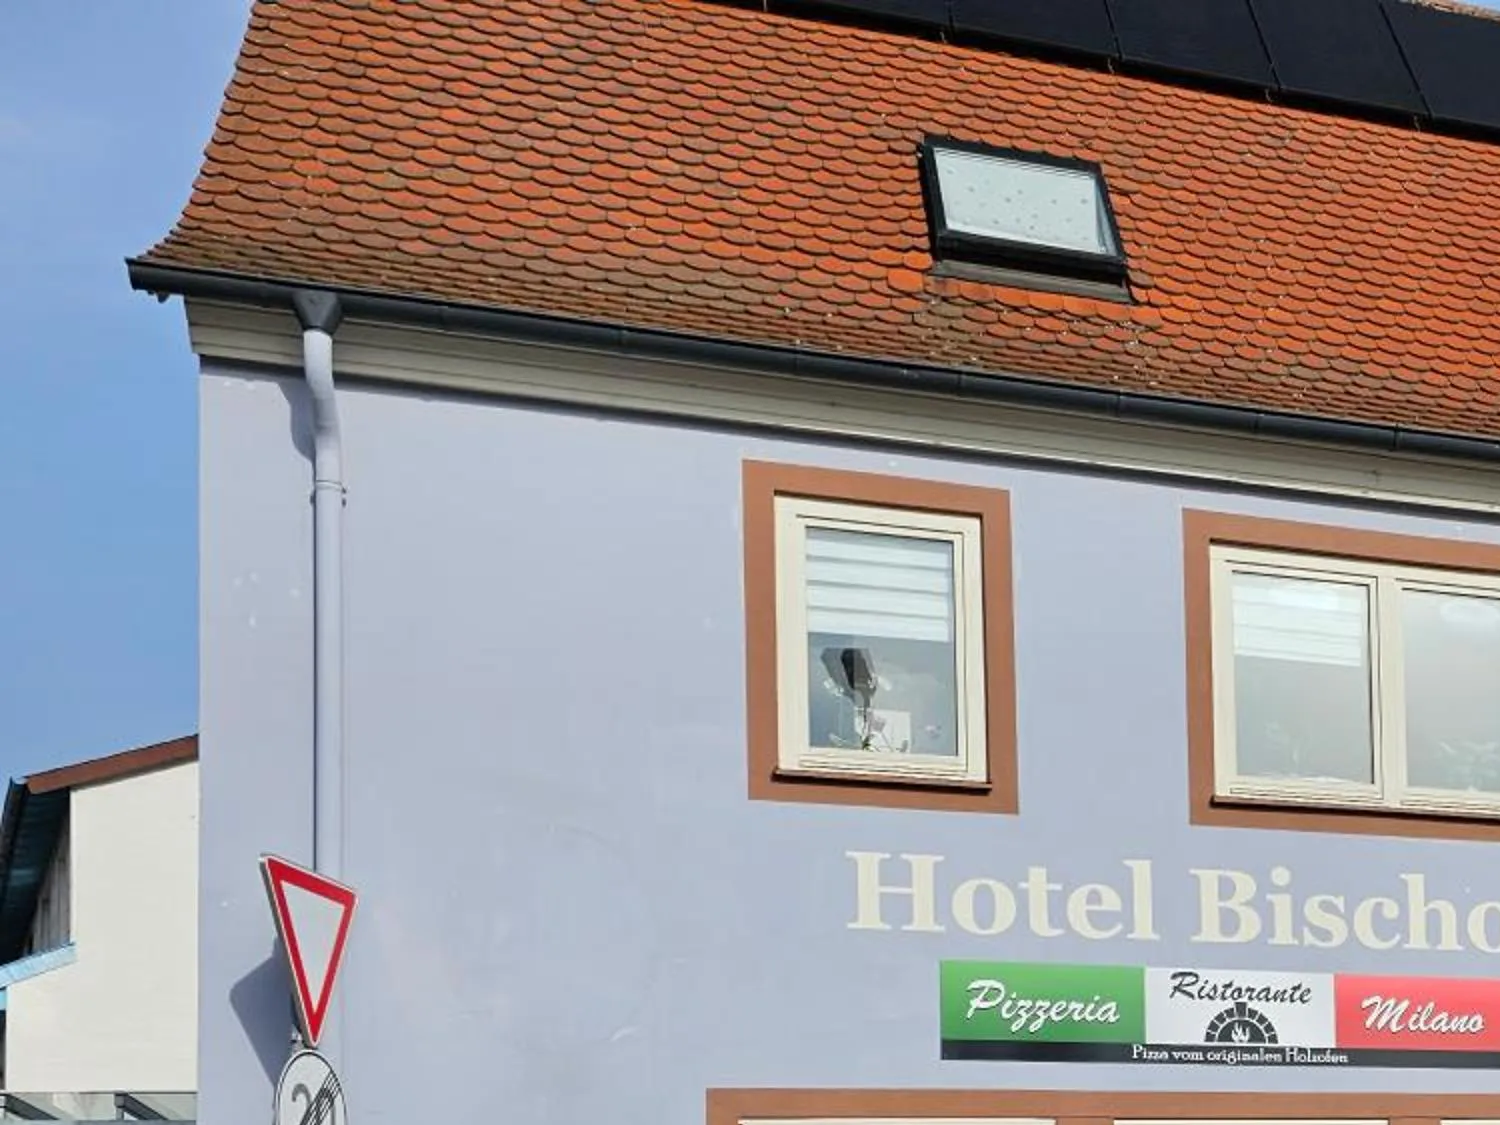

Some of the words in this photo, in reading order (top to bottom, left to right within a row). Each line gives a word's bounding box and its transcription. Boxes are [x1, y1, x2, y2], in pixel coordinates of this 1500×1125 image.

[846, 849, 1158, 942] Hotel
[966, 979, 1121, 1034] Pizzeria
[1169, 971, 1312, 1005] Ristorante
[1361, 995, 1486, 1034] Milano
[1171, 1050, 1204, 1061] vom
[1206, 1047, 1283, 1064] originalen
